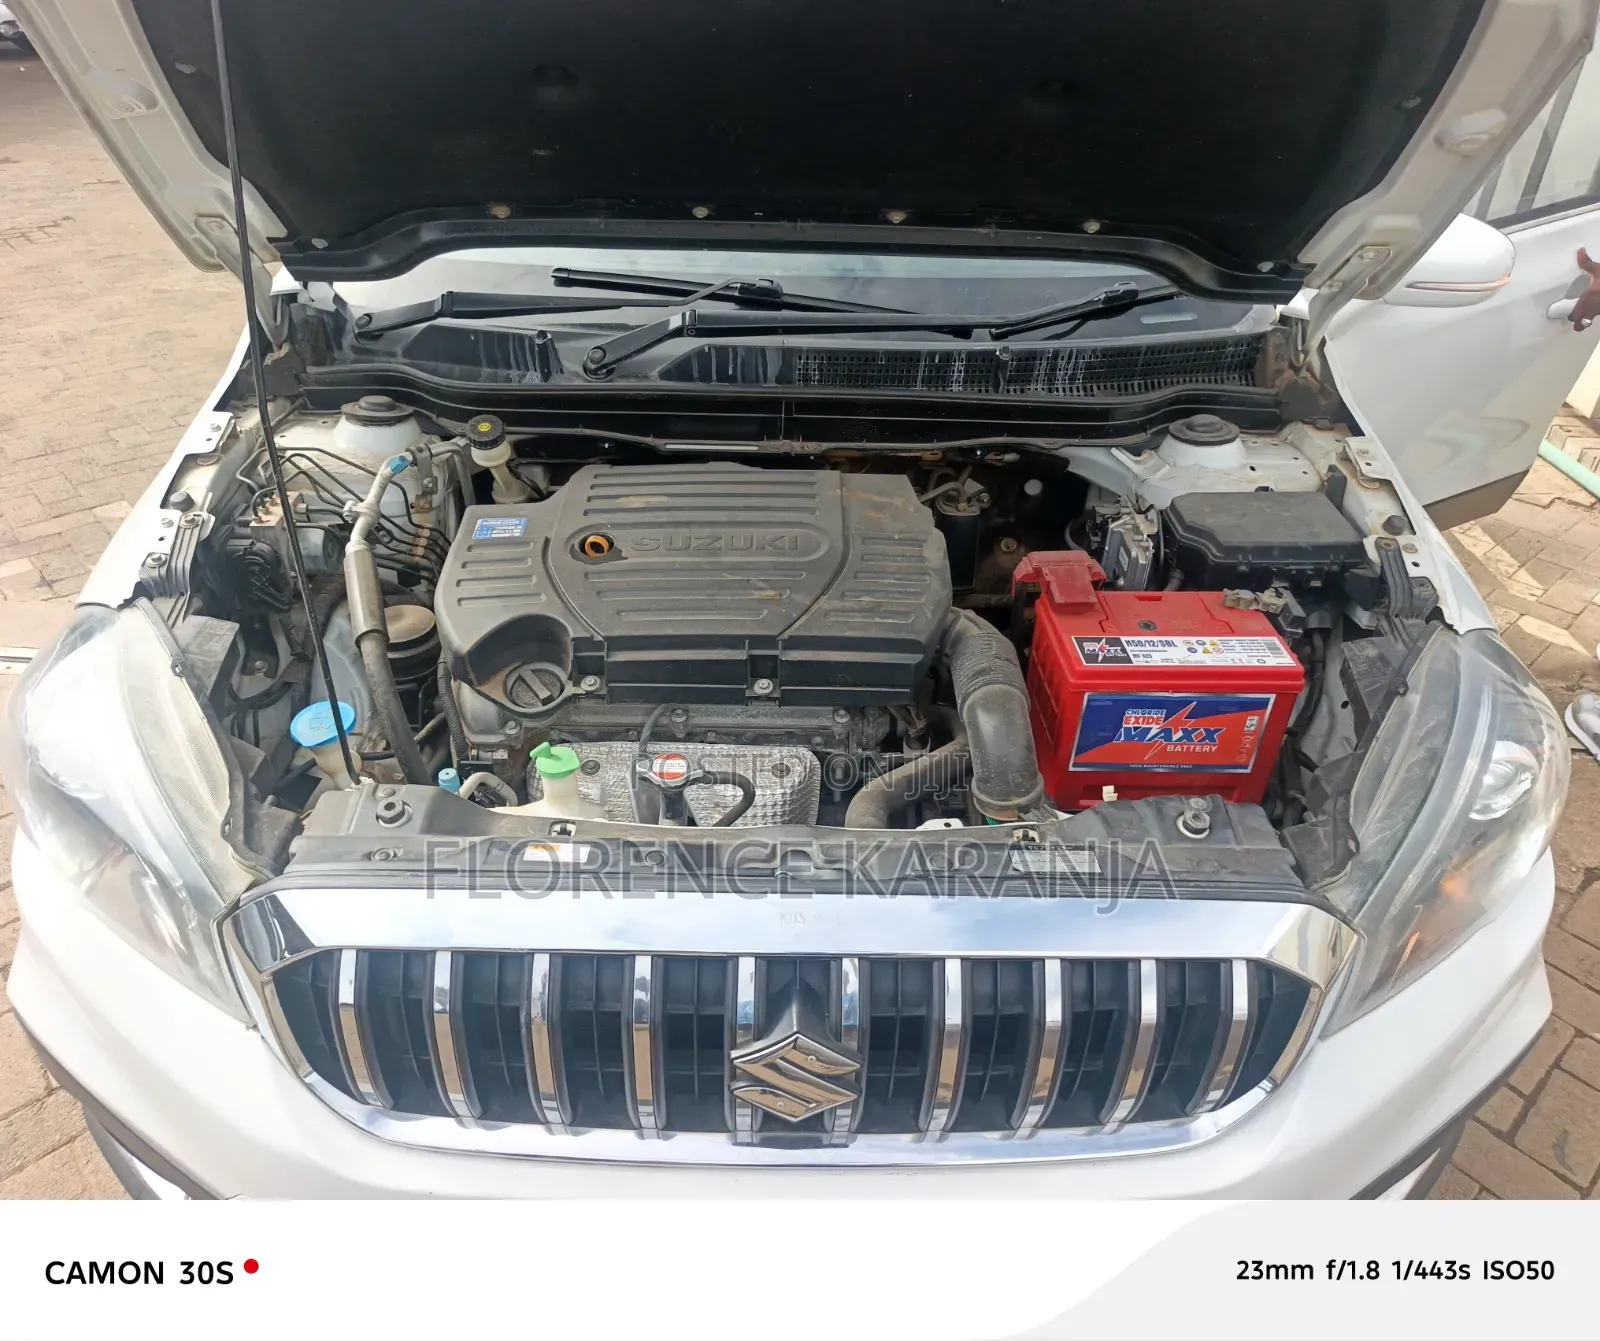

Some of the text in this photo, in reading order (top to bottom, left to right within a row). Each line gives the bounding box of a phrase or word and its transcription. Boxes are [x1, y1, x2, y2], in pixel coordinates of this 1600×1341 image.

[629, 533, 799, 552] SUZUKI
[1123, 716, 1164, 726] EXIDE
[1113, 727, 1226, 744] MAXX
[1166, 744, 1218, 752] BATTERY
